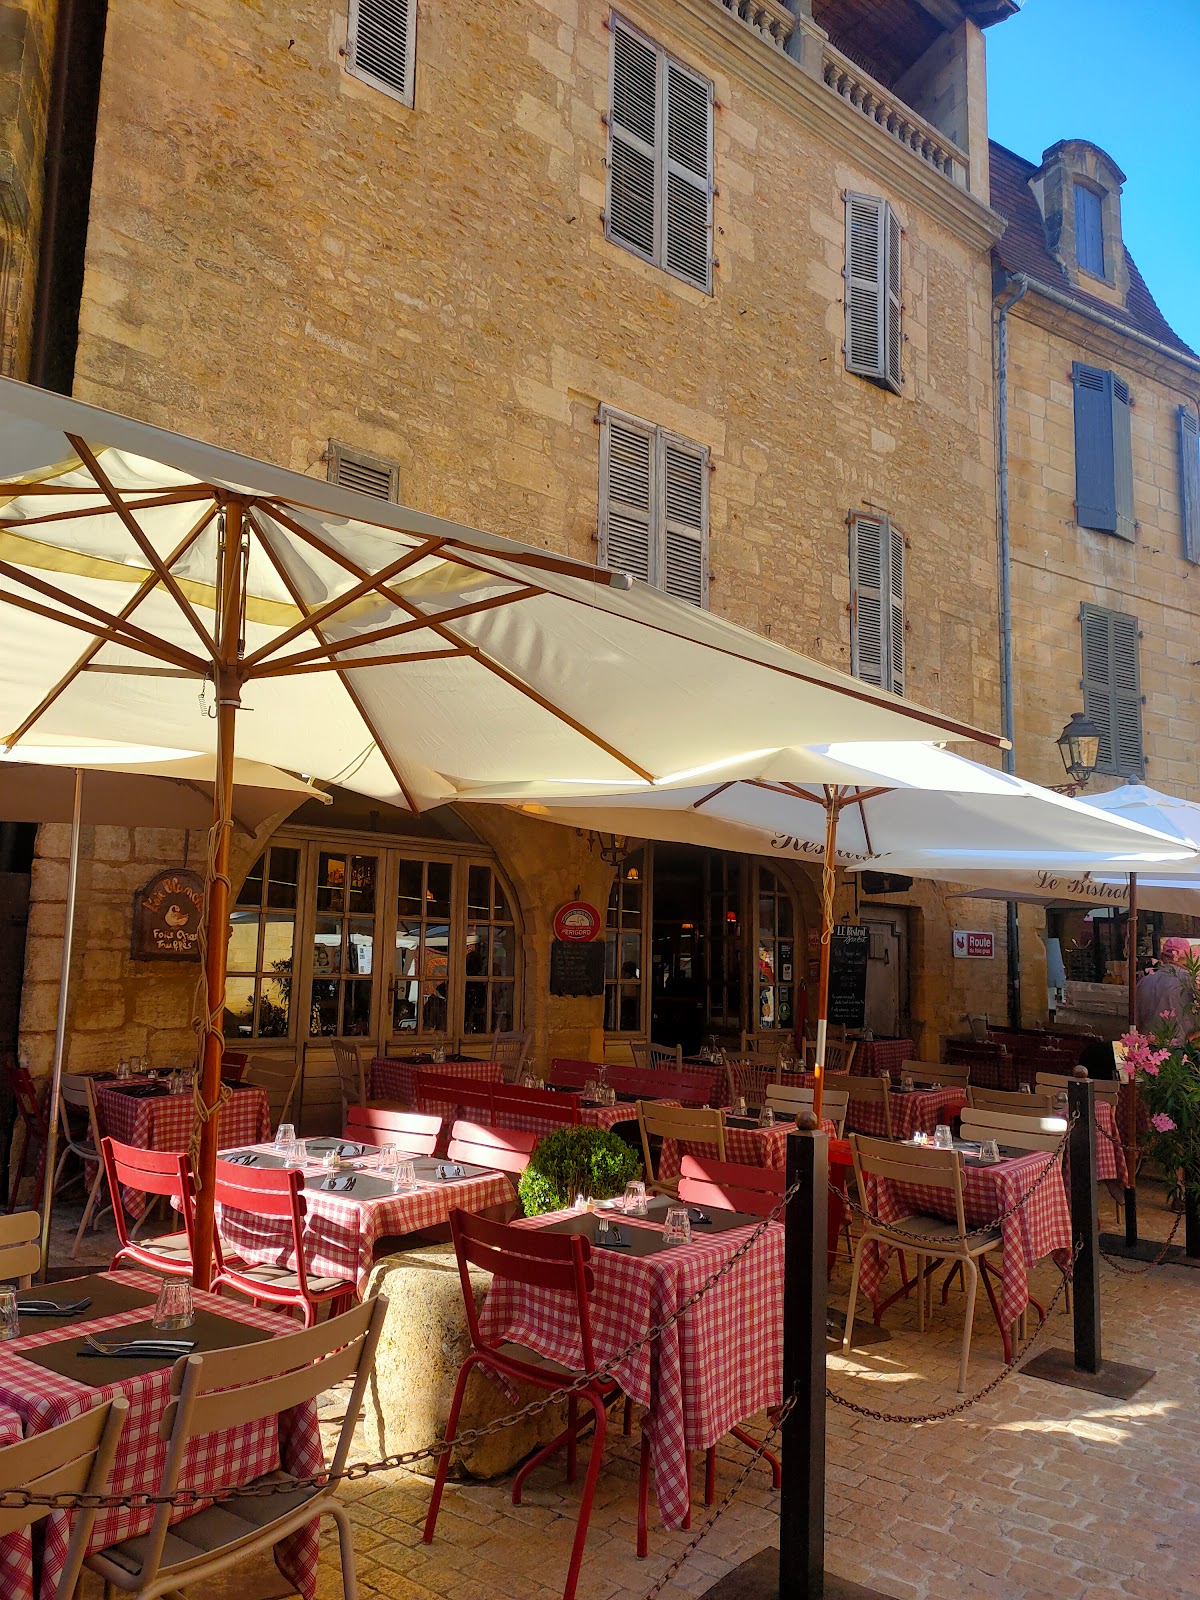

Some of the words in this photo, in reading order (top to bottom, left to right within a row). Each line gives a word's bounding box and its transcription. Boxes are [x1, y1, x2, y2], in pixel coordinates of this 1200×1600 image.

[1035, 870, 1061, 891] Le
[1067, 879, 1130, 900] Bistrot
[969, 936, 991, 947] Route
